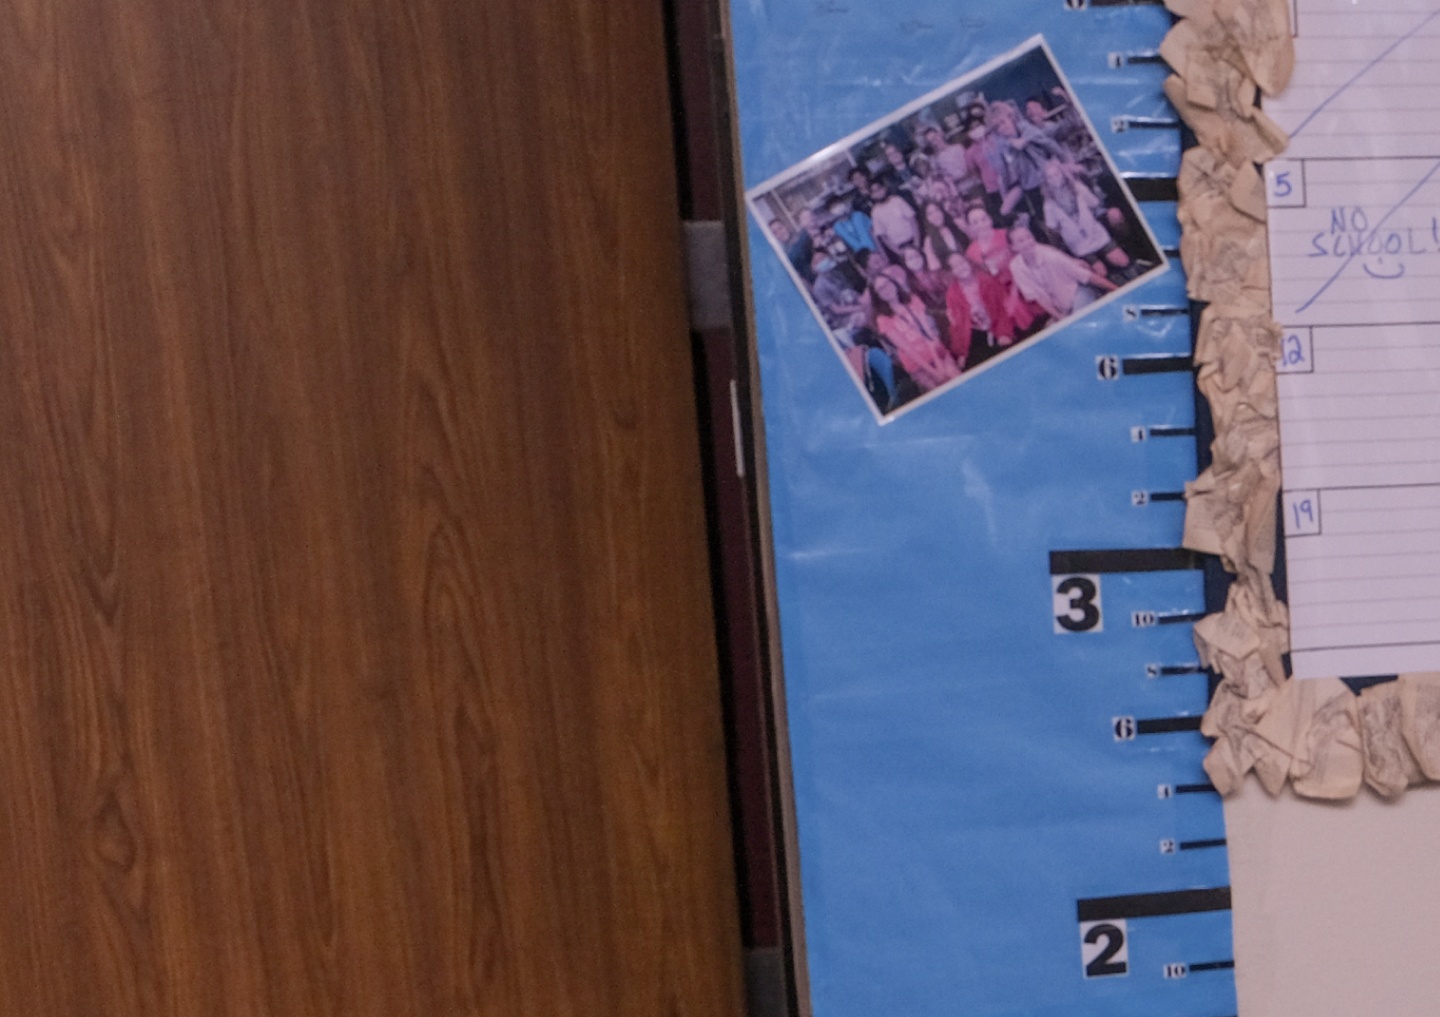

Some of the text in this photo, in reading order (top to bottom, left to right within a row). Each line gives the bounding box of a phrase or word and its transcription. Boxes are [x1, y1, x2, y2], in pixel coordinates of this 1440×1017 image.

[1273, 171, 1293, 198] 5
[1330, 206, 1368, 235] NO
[1281, 333, 1305, 367] 12
[1098, 358, 1117, 380] 6
[1133, 492, 1145, 505] 2
[1292, 500, 1314, 530] 19
[1056, 577, 1099, 632] 3
[1134, 612, 1154, 626] 10
[1114, 718, 1133, 739] 6
[1162, 842, 1173, 854] 2
[1084, 923, 1127, 977] 2
[1166, 965, 1186, 978] 10
